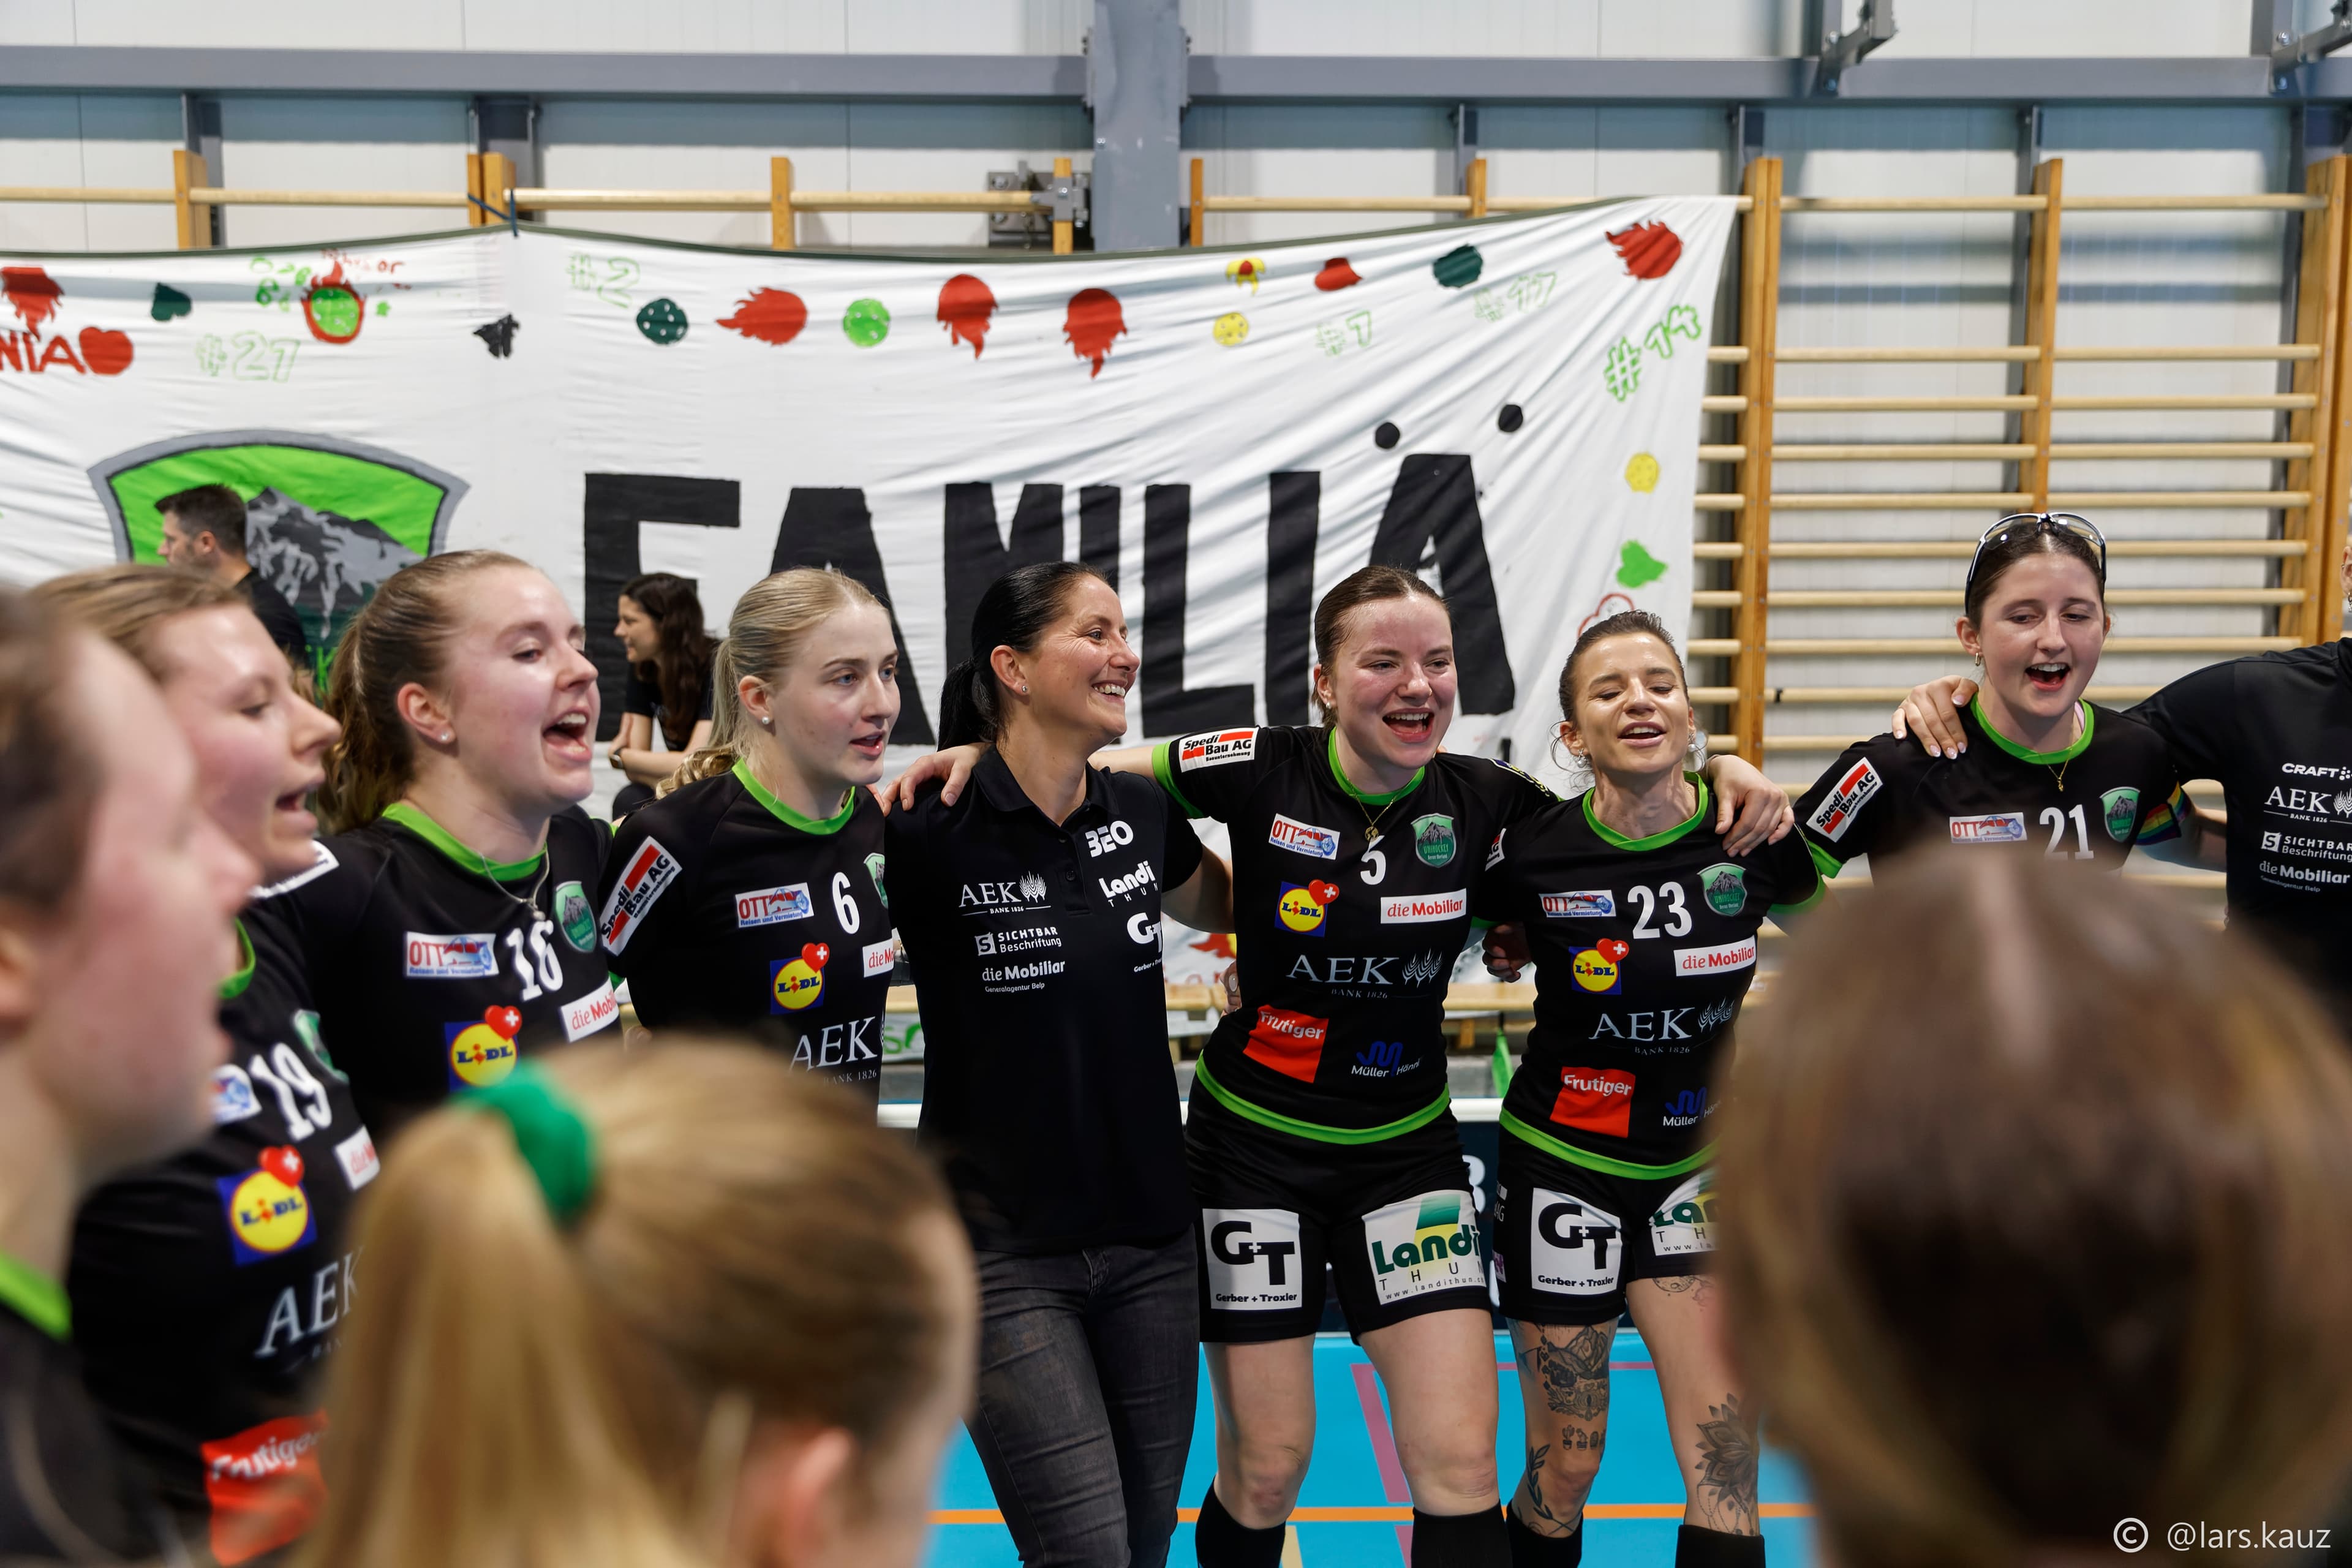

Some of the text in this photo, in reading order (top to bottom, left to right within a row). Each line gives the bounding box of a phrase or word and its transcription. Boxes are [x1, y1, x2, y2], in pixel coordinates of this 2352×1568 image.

[1184, 734, 1220, 750] Spedi
[1205, 739, 1252, 755] Bau AG
[2282, 763, 2340, 778] CRAFT
[1838, 771, 1875, 814] Bau AG
[2264, 786, 2332, 813] AEK
[1816, 791, 1844, 827] Spedi
[1272, 820, 1299, 843] OTT
[1951, 821, 1980, 837] OTT
[2039, 804, 2094, 861] 21
[1270, 837, 1285, 846] Reisen
[1297, 846, 1323, 858] Vermietung
[2282, 845, 2352, 862] Beschriftung
[2283, 835, 2352, 851] SICHTBAR
[1360, 834, 1387, 886] 5
[1099, 860, 1156, 899] Landi
[2260, 861, 2351, 884] die Mobiliar
[624, 854, 671, 916] Bau AG
[959, 882, 1022, 908] AEK
[601, 885, 631, 939] Spedi
[739, 895, 770, 919] OTT
[831, 872, 861, 935] 6
[1387, 899, 1463, 918] die Mobiliar
[1627, 881, 1693, 940] 23
[998, 926, 1058, 942] SICHTBAR
[1000, 937, 1062, 954] Beschriftung
[409, 940, 448, 967] OTT
[505, 919, 564, 1002] 16
[868, 951, 884, 969] die
[1682, 946, 1754, 970] die Mobiliar
[982, 960, 1065, 981] die Mobiliar
[1286, 954, 1400, 985] AEK
[985, 984, 1030, 993] Generalagentur
[1332, 987, 1388, 1000] BANK 1826
[571, 1009, 591, 1030] die
[1259, 1011, 1324, 1039] Frutiger
[1588, 1007, 1695, 1042] AEK
[788, 1016, 878, 1072] AEK
[1634, 1046, 1664, 1056] BANK
[858, 1069, 877, 1080] 1826
[1351, 1065, 1389, 1077] Müller
[249, 1042, 333, 1141] 19
[1564, 1074, 1632, 1096] Frutiger
[1662, 1115, 1699, 1126] Müller
[1371, 1224, 1480, 1275] Landi
[1537, 1275, 1577, 1287] Gerber
[1586, 1276, 1614, 1287] Troxler
[253, 1246, 365, 1358] AEK
[1216, 1293, 1249, 1302] Gerber
[1259, 1292, 1297, 1302] Troxler
